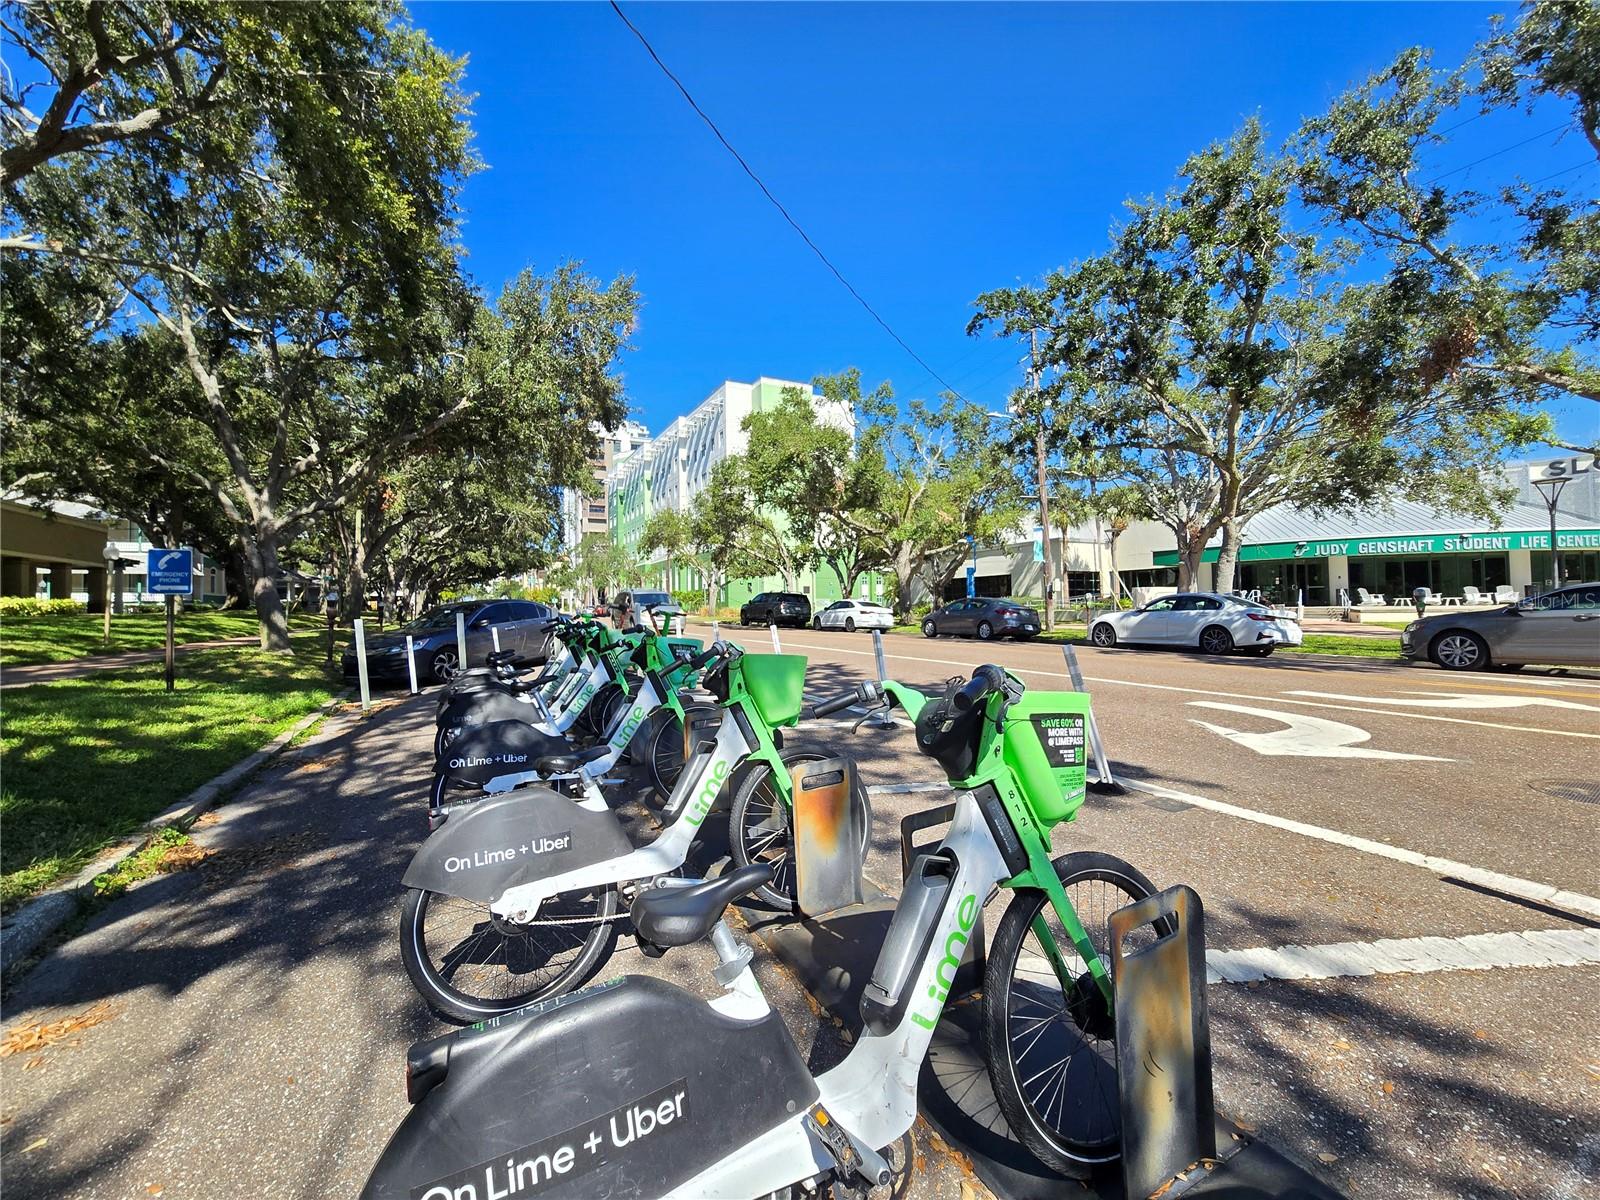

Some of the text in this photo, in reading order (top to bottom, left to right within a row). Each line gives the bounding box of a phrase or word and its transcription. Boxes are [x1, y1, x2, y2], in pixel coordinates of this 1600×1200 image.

[1314, 534, 1600, 556] JUDY GENSHAFT STUDENT LIFE CENTE
[568, 683, 596, 716] Lime
[612, 706, 644, 749] Lime
[1041, 719, 1060, 727] SAVE
[1047, 728, 1083, 737] MORE WITH
[1055, 737, 1084, 746] LIMEPASS
[449, 759, 465, 768] On
[467, 757, 492, 767] Lime
[503, 754, 527, 763] Uber
[684, 760, 728, 827] Lime
[444, 835, 570, 873] On Lime + Uber
[910, 894, 979, 1031] Lime
[485, 1146, 575, 1200] Lime
[583, 1131, 603, 1154] +
[609, 1091, 685, 1148] Uber
